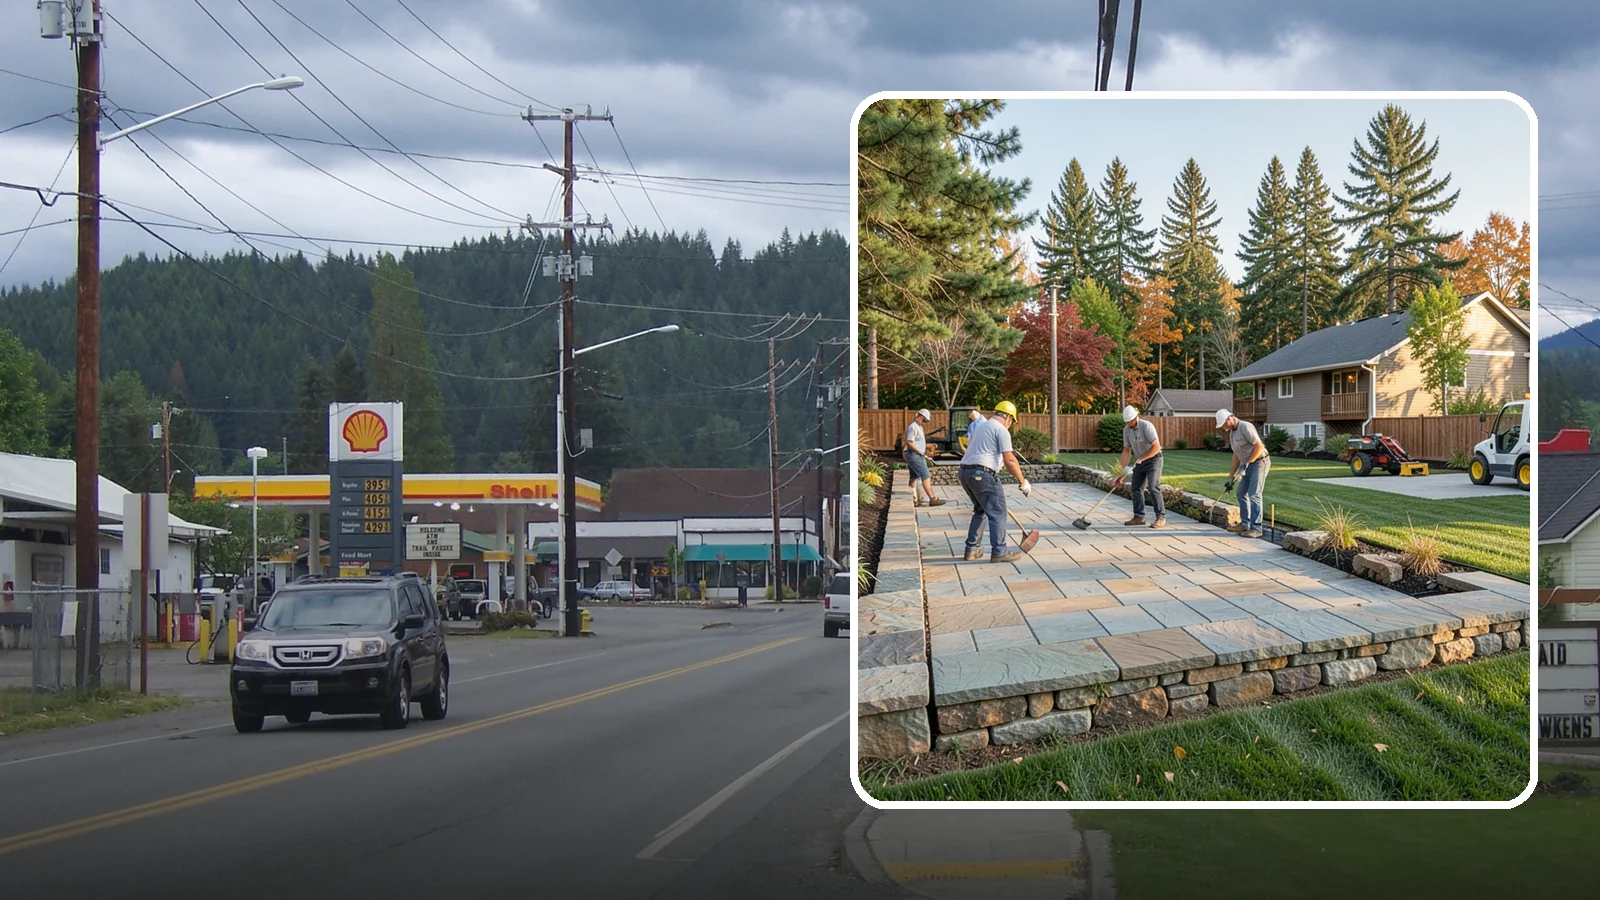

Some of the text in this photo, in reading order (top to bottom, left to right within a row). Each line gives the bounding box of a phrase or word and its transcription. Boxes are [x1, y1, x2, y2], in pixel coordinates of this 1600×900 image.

[365, 480, 384, 490] 395
[490, 484, 547, 499] Shell
[365, 494, 384, 504] 405
[365, 508, 384, 518] 415
[365, 522, 384, 532] 429
[1539, 643, 1567, 665] AID
